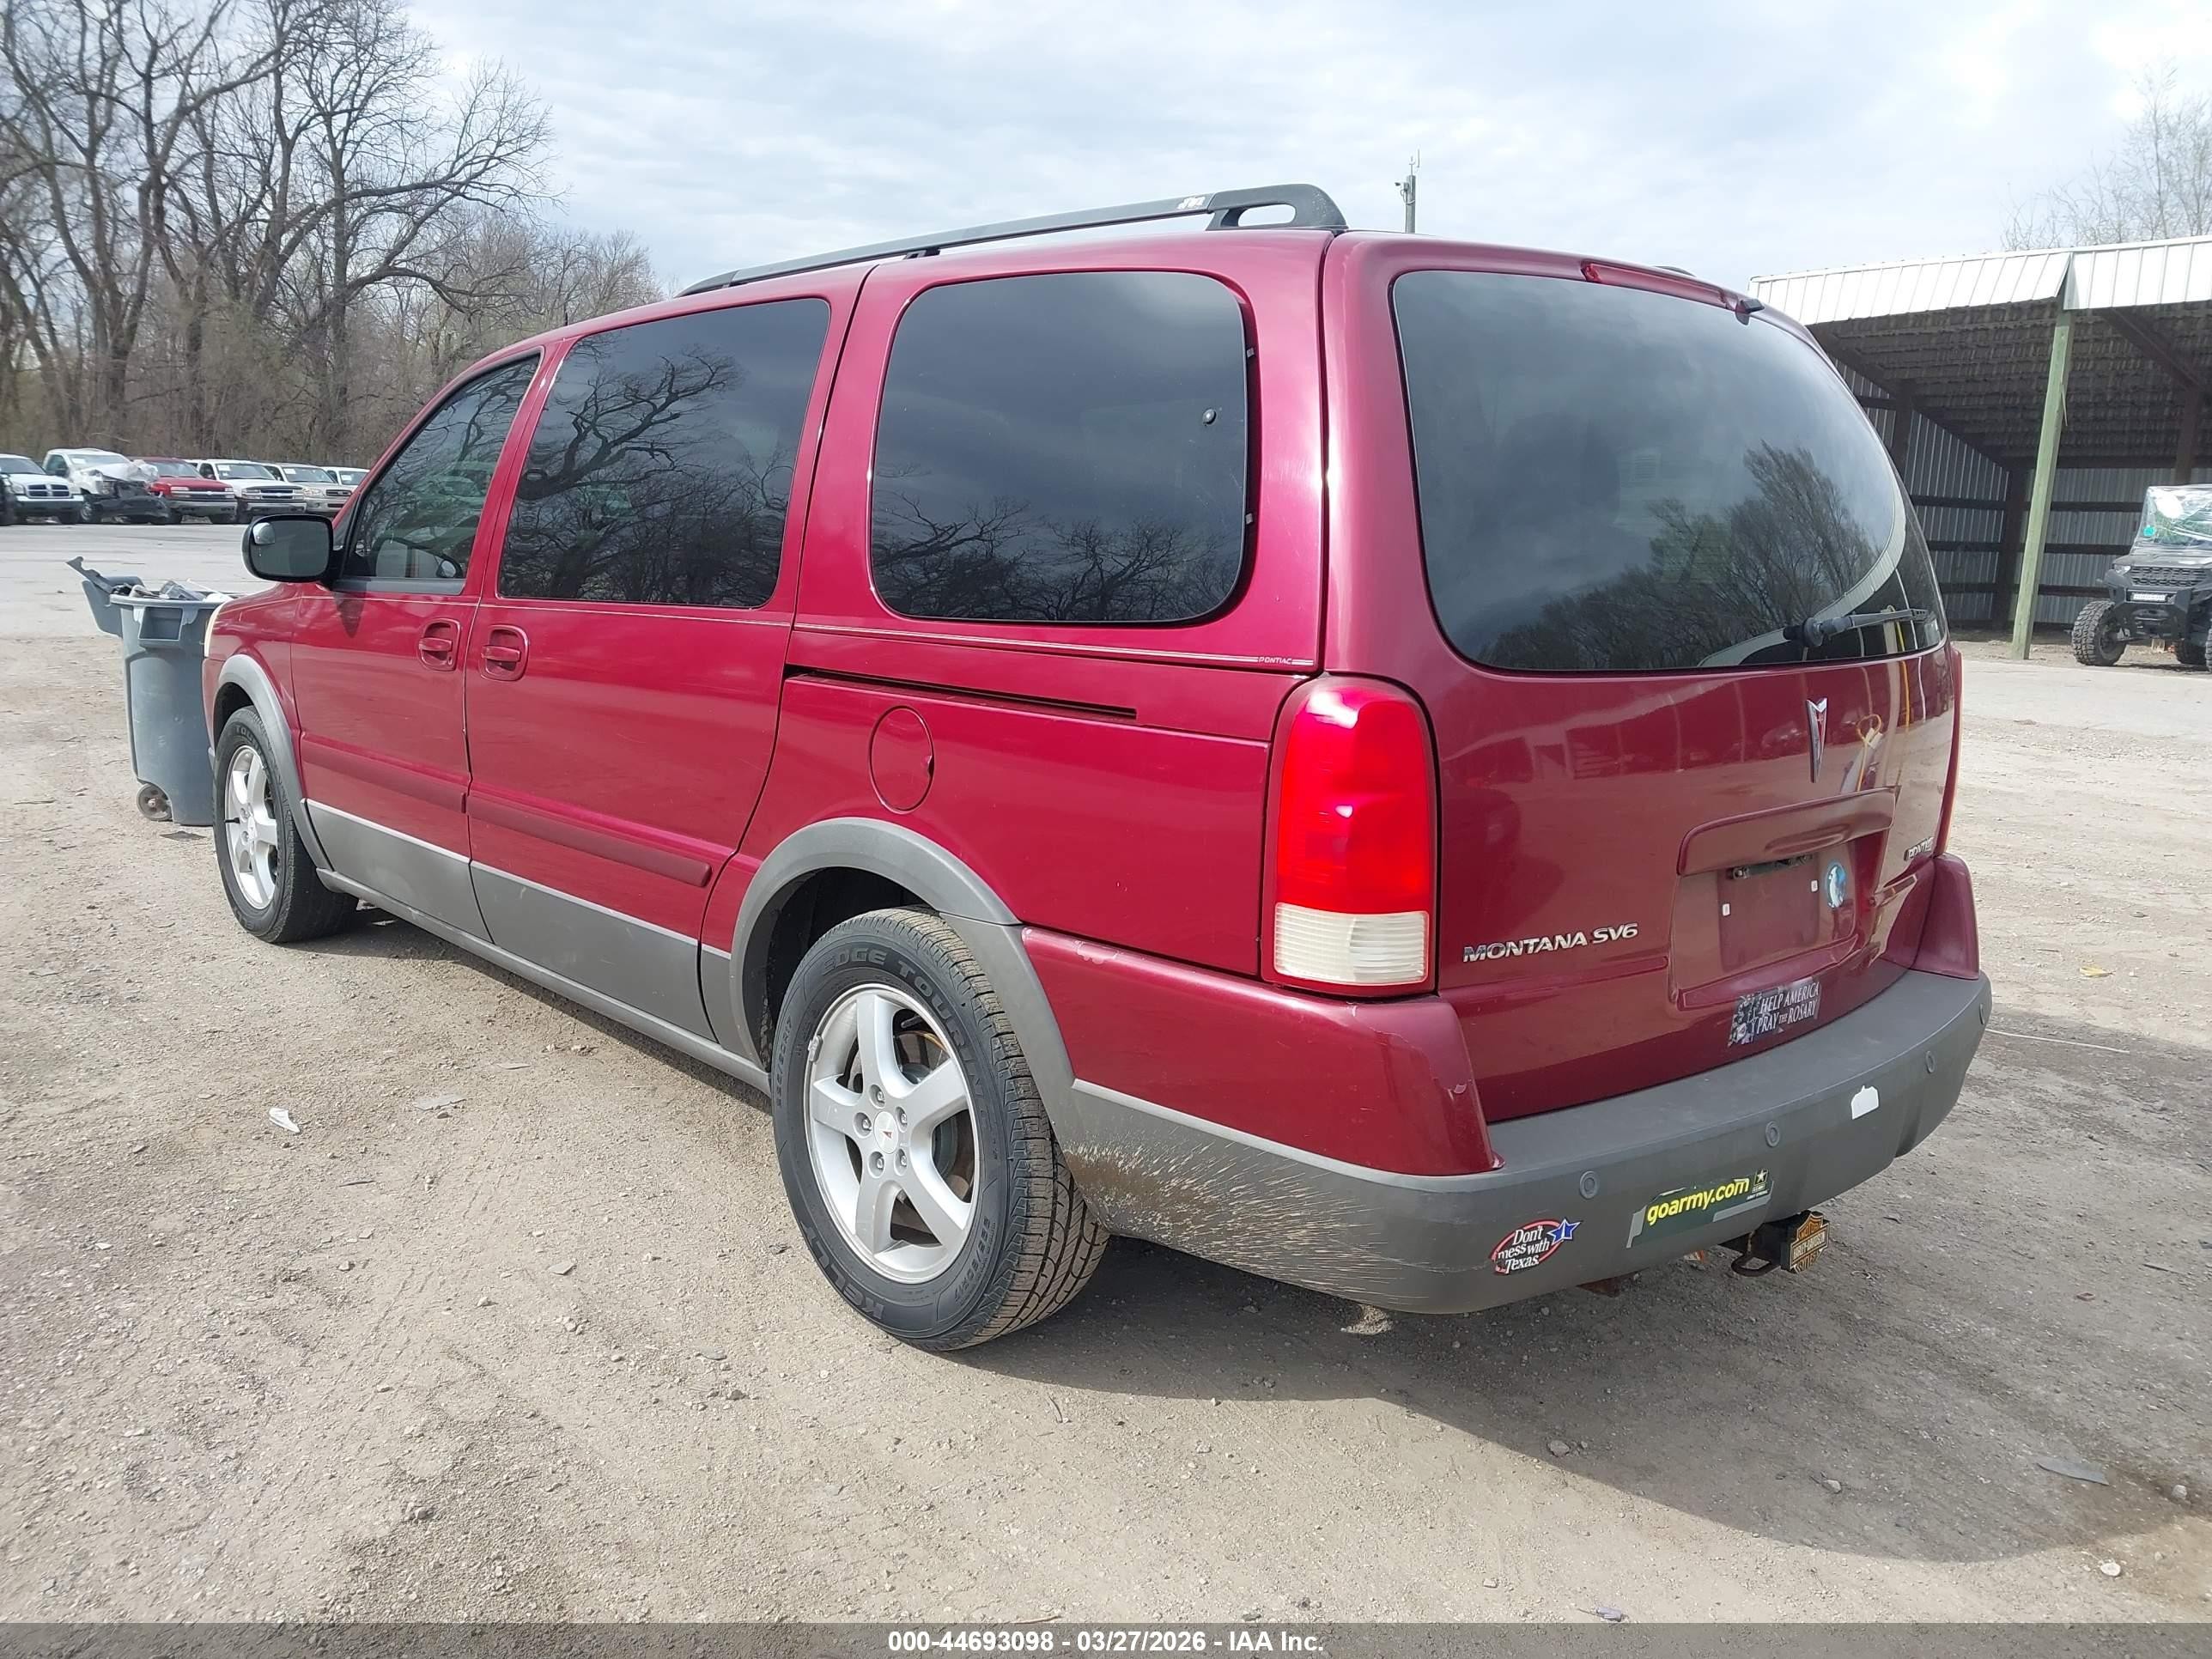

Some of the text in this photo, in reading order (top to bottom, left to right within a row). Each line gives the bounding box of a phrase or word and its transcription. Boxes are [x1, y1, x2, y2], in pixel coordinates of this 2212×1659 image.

[1258, 656, 1291, 665] PONTIAC
[1462, 923, 1638, 963] MONTANA SV6
[822, 947, 887, 975] EDGE
[1760, 982, 1820, 1013] HELP AMERICA
[1756, 1000, 1818, 1035] PRAY THE ROSARY
[1647, 1178, 1750, 1225] goarmy.com
[1498, 1237, 1551, 1260] mess with
[1512, 1225, 1544, 1246] Don't
[800, 1220, 885, 1320] KELLY
